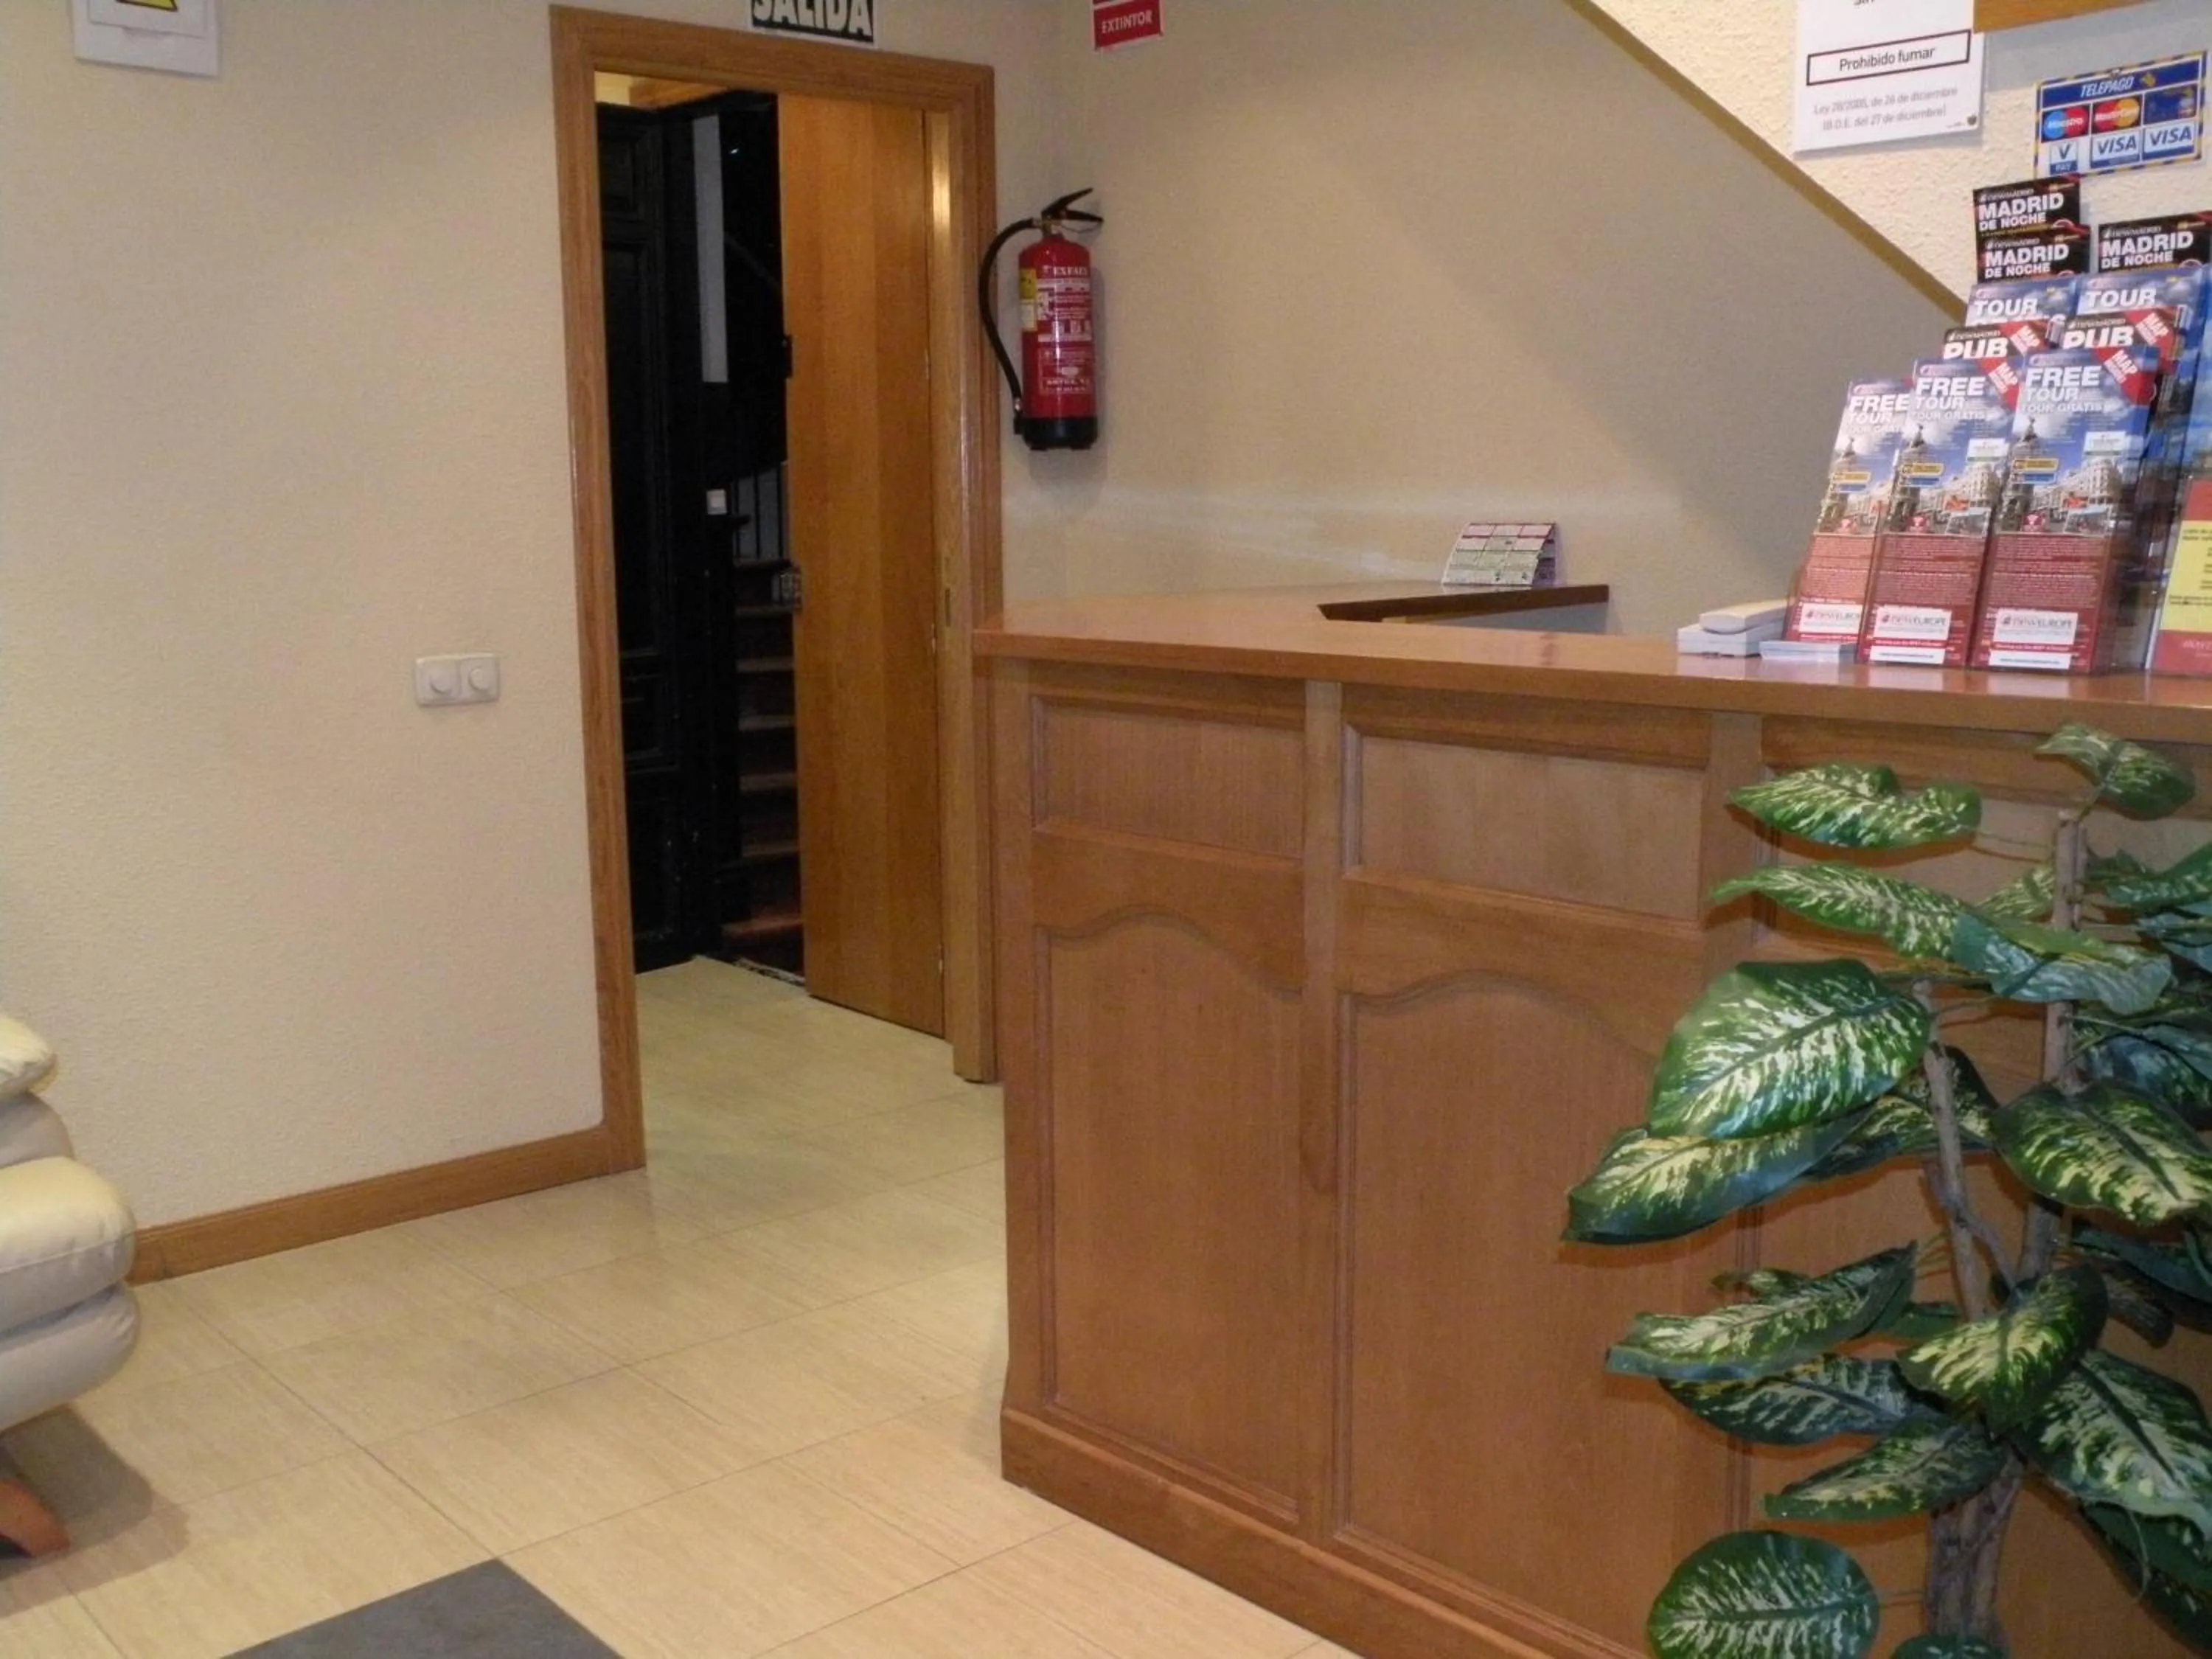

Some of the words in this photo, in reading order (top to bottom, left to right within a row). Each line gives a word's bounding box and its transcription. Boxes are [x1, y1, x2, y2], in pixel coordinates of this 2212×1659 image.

[1102, 10, 1152, 34] EXTINTOR
[1840, 53, 1895, 72] Prohibido
[1898, 47, 1935, 63] fumar
[2080, 76, 2135, 97] TELEPAGO
[2097, 135, 2138, 154] VISA
[2149, 126, 2193, 146] VISA
[1978, 192, 2064, 220] MADRID
[1979, 219, 1997, 232] DE
[2001, 212, 2047, 229] NOCHE
[2102, 231, 2194, 257] MADRID
[1985, 244, 2070, 267] MADRID
[2101, 257, 2121, 270] DE
[2124, 251, 2174, 267] NOCHE
[1984, 266, 2003, 279] DE
[2006, 262, 2051, 277] NOCHE
[1974, 297, 2038, 316] TOUR
[2084, 287, 2157, 308] TOUR
[2062, 324, 2135, 349] PUB
[1943, 337, 2009, 360] PUB
[2026, 365, 2103, 387] FREE
[1916, 377, 1986, 396] FREE
[2025, 387, 2080, 403] TOUR
[1849, 393, 1910, 413] FREE
[1915, 396, 1966, 410] TOUR
[1848, 412, 1893, 425] TOUR
